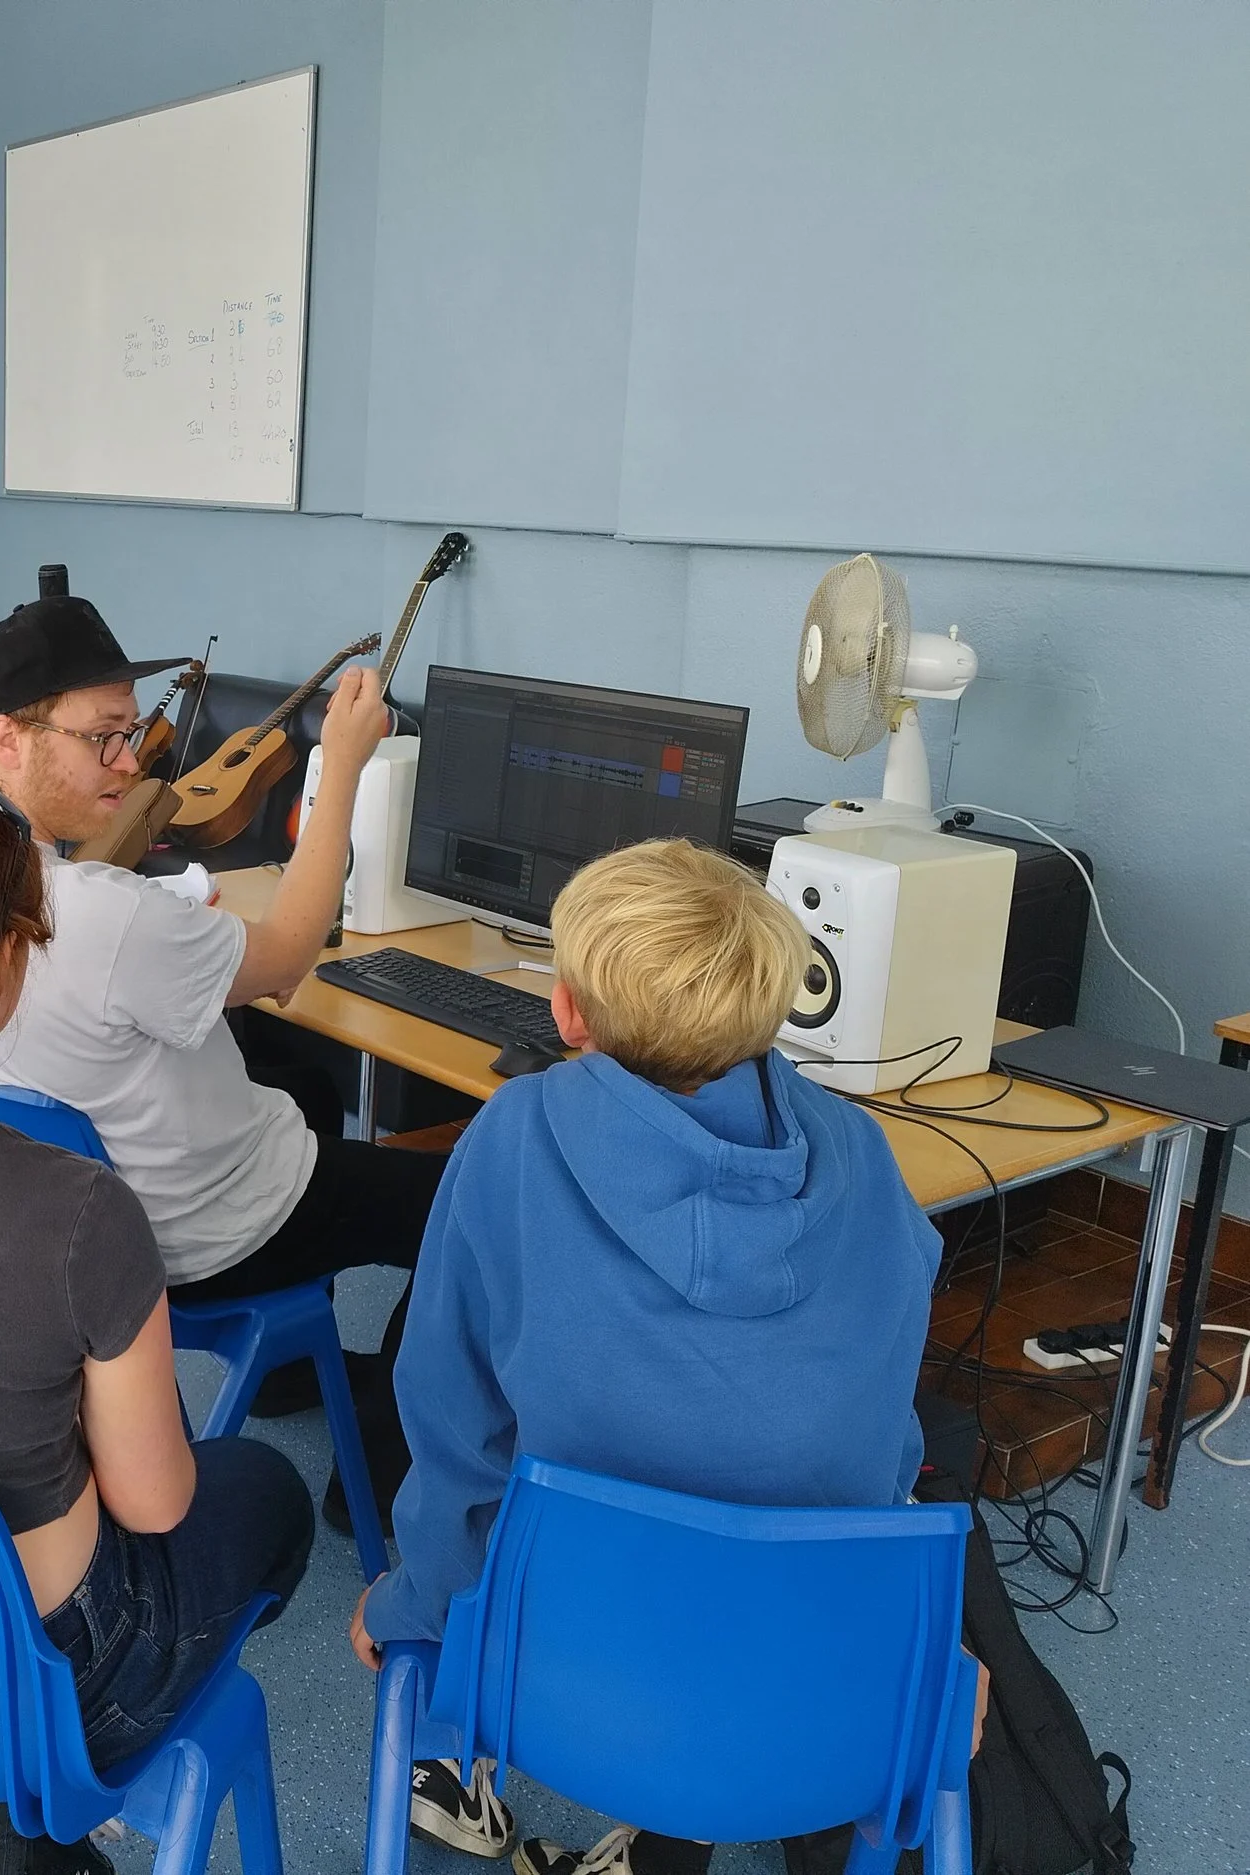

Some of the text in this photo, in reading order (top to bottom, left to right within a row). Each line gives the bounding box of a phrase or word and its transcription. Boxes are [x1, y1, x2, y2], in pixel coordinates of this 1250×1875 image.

[222, 299, 254, 316] DISTANCE
[209, 377, 215, 390] 3
[266, 390, 282, 409] 62
